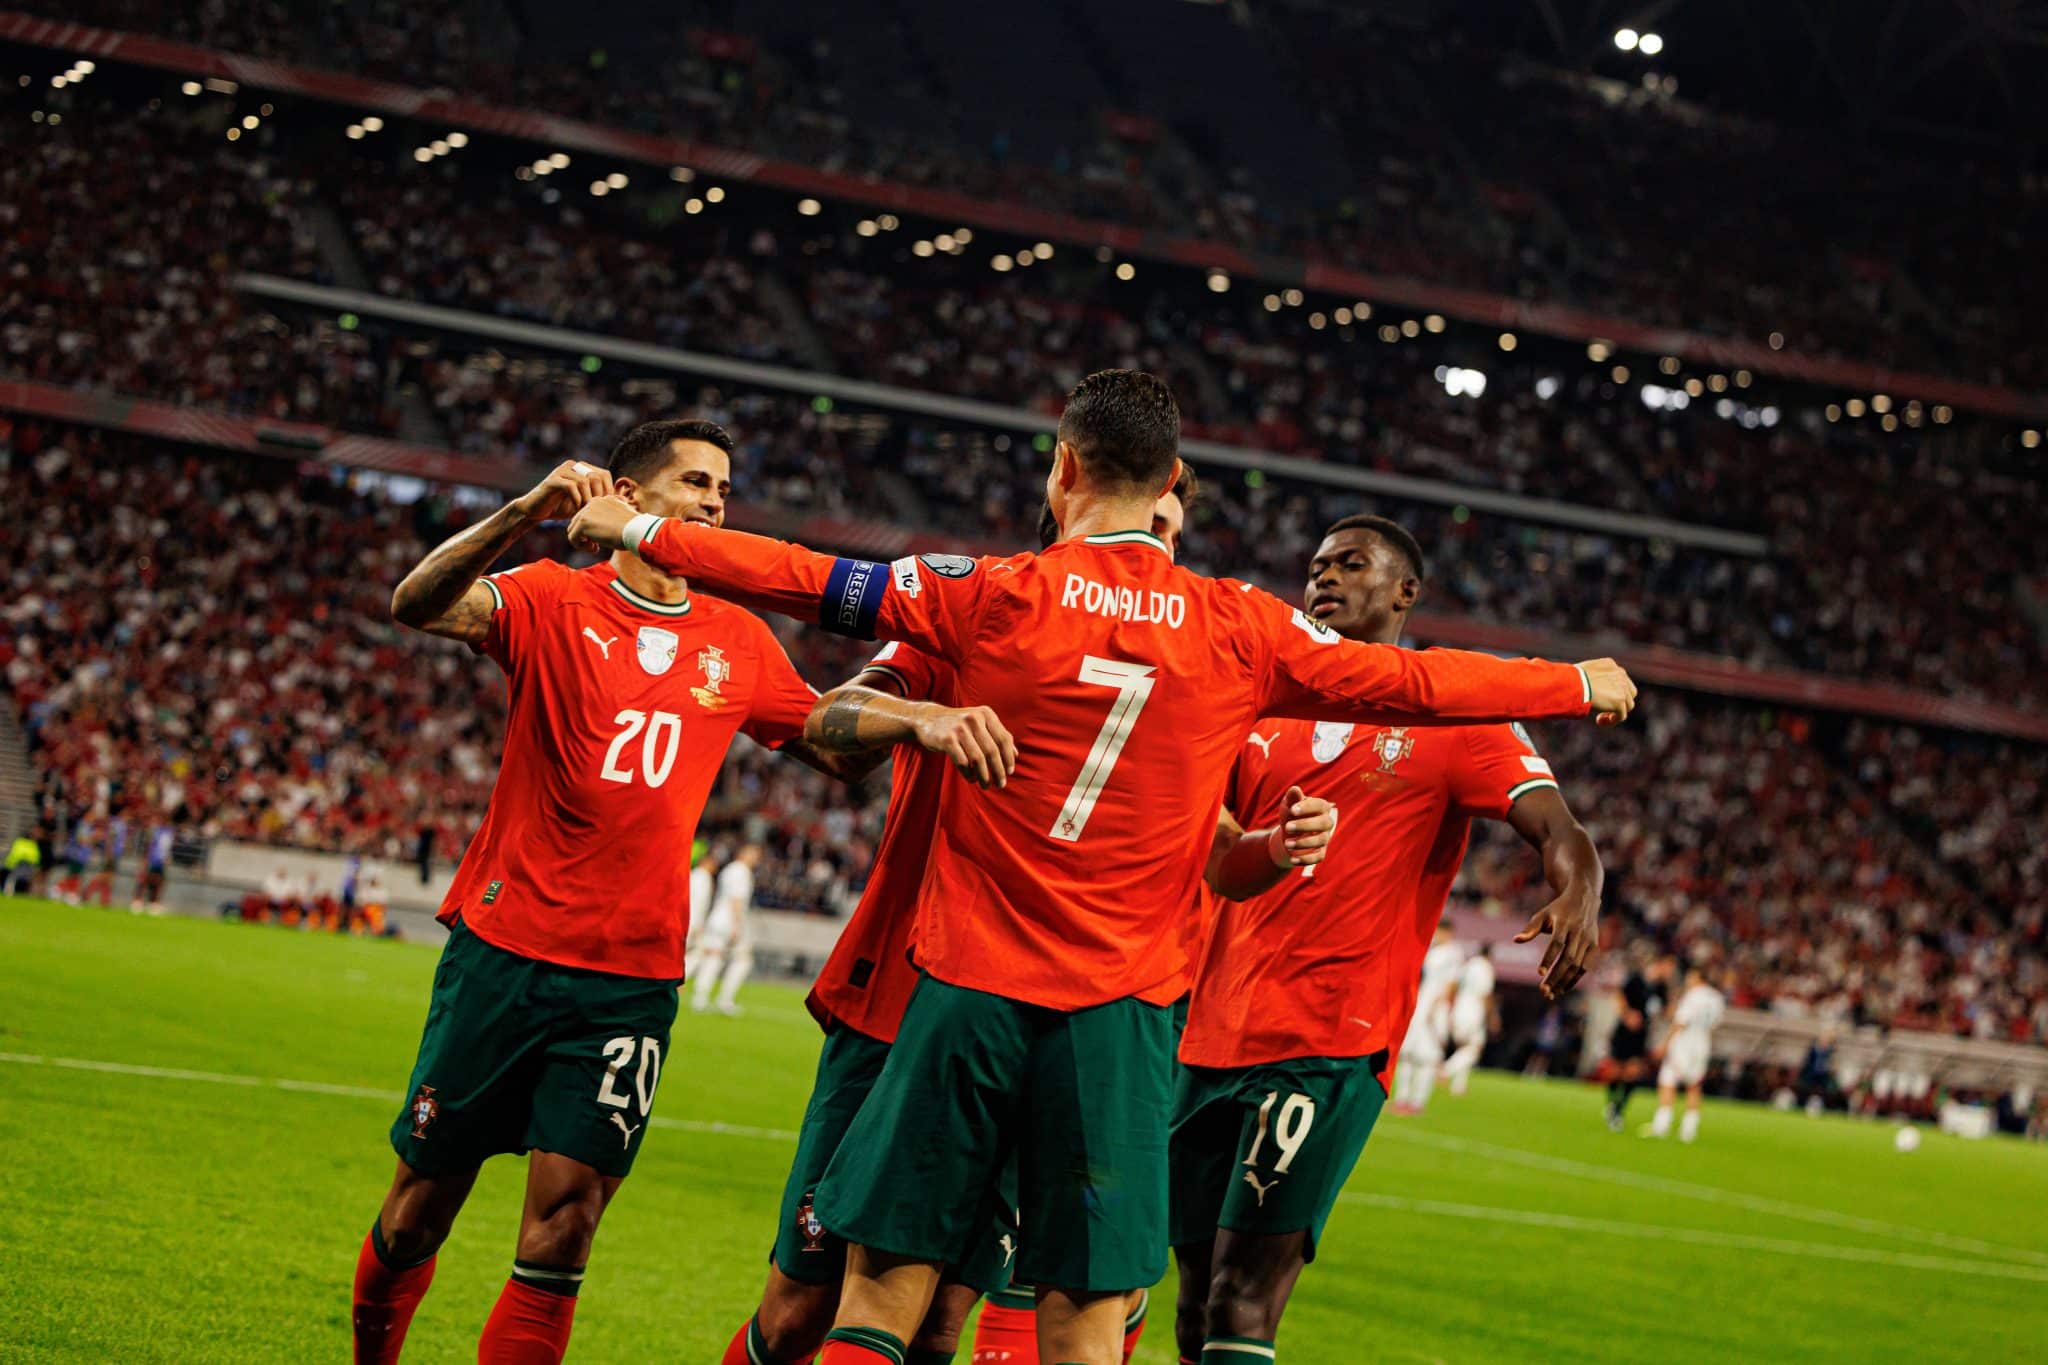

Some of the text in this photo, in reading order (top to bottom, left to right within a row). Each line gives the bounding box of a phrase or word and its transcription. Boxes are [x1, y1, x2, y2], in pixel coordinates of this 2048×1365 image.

[842, 572, 865, 626] RESPECT
[1061, 573, 1185, 629] RONALDO
[600, 709, 682, 788] 20
[1048, 654, 1158, 842] 7
[597, 1036, 660, 1117] 20
[1242, 1091, 1315, 1174] 19
